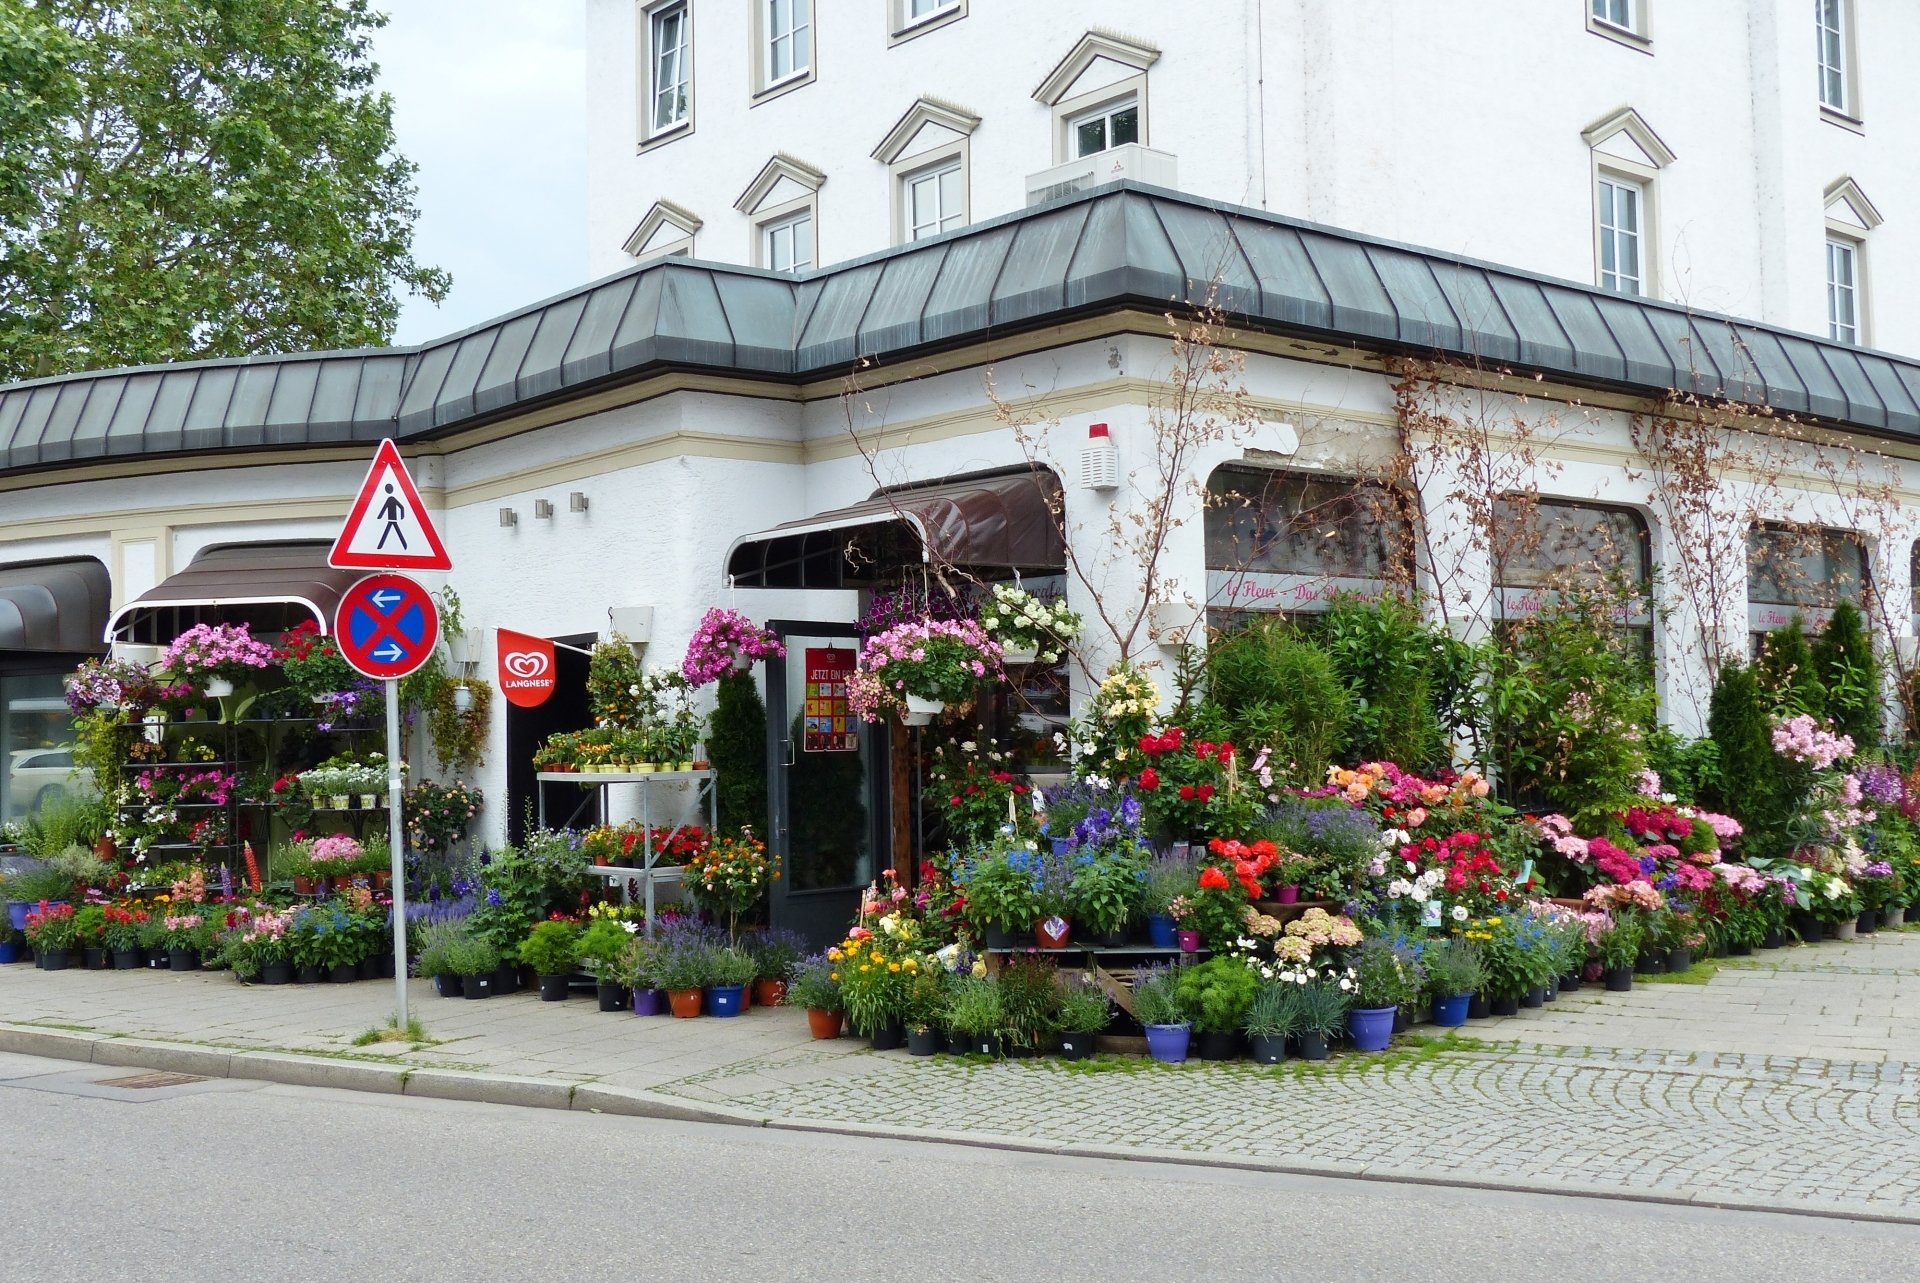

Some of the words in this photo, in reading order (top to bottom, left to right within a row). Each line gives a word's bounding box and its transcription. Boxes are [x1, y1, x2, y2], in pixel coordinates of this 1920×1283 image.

[1227, 580, 1238, 597] le
[1242, 581, 1276, 598] Fleur
[1295, 584, 1319, 601] Das
[810, 669, 829, 680] JETZT
[831, 669, 841, 680] EIN
